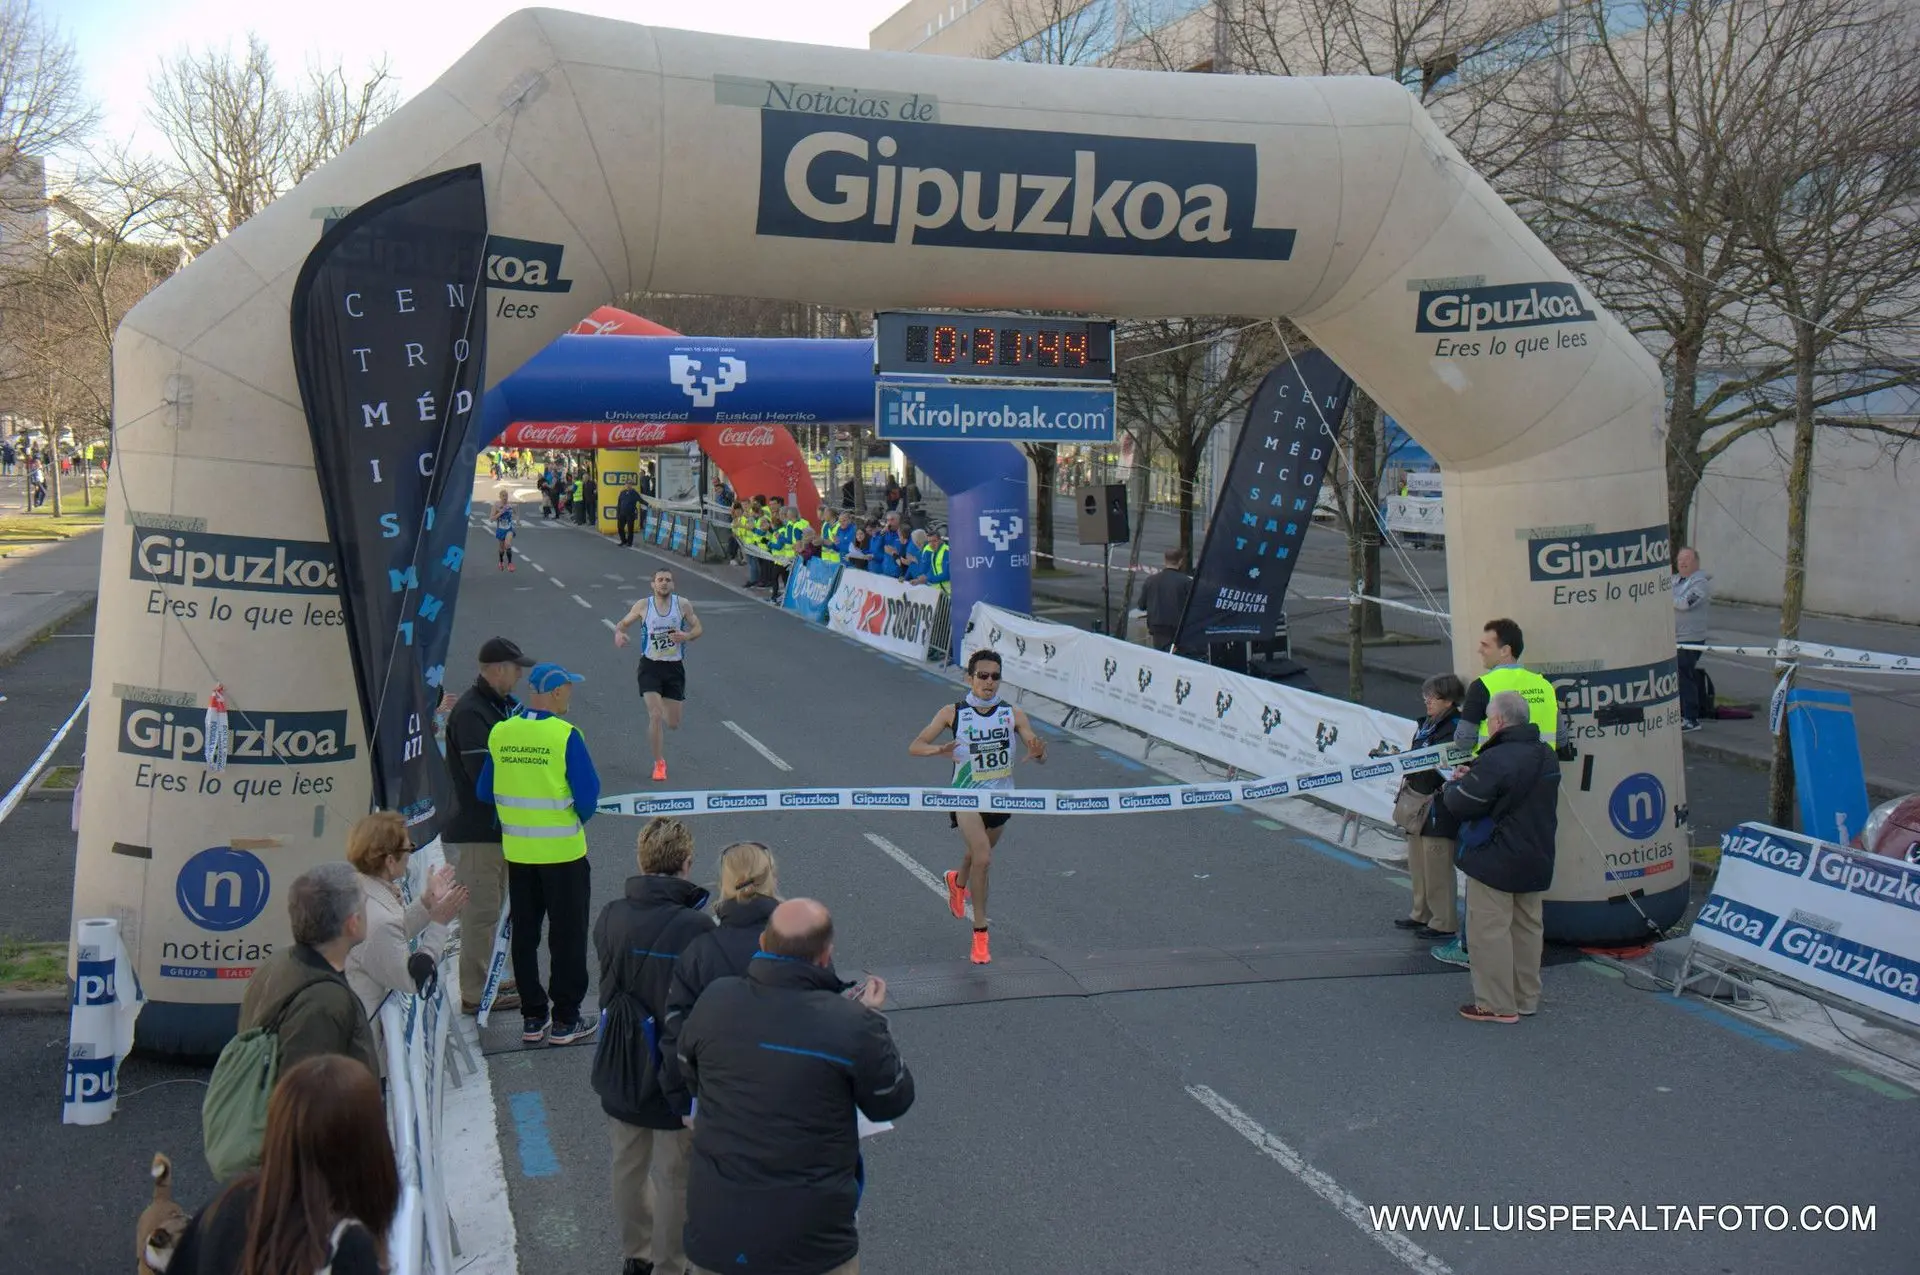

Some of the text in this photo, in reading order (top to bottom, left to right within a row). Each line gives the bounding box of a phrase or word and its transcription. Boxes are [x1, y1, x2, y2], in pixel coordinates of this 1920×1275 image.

[762, 80, 933, 121] Noticias de
[784, 131, 1232, 246] Gipuzkoa
[496, 296, 539, 319] lees
[1426, 288, 1582, 331] Gipuzkoa
[935, 325, 1087, 366] 0:31:44
[1435, 330, 1588, 358] Eres lo que lees
[605, 410, 816, 420] Universidad Euskal Herriko
[900, 402, 1106, 433] Kirolprobak.com
[517, 424, 581, 445] Coca-Cola
[608, 423, 668, 444] Coca-Cola
[718, 426, 776, 447] Coca-Cola
[965, 555, 1030, 569] UPV EHU
[1537, 534, 1670, 578] Gipuzkoa
[1215, 598, 1266, 613] DEPORTIVA
[1219, 587, 1268, 604] MEDICINA
[1553, 585, 1597, 605] Eres
[1606, 582, 1621, 600] lo
[1628, 580, 1655, 602] que
[147, 590, 345, 630] Eres lo que lees
[1637, 715, 1662, 737] que
[974, 750, 1009, 770] 180
[135, 763, 334, 803] Eres lo que lees
[636, 799, 693, 814] Gipuzkoa
[709, 796, 766, 808] Gipuzkoa
[781, 793, 838, 806] Gipuzkoa
[853, 793, 909, 806] Gipuzkoa
[923, 794, 978, 807] Gipuzkoa
[992, 795, 1045, 809] Gipuzkoa
[1057, 798, 1109, 810] Gipuzkoa
[1120, 794, 1170, 808] Gipuzkoa
[1183, 790, 1231, 804] Gipuzkoa
[1242, 781, 1288, 799] Gipuzkoa
[1299, 772, 1342, 790] Gipuzkoa
[1353, 762, 1394, 780] Gipuzkoa
[1605, 842, 1673, 866] noticias
[1721, 833, 1804, 871] uzkoa
[1819, 852, 1920, 906] Gipuzk
[1699, 902, 1765, 940] zkoa
[163, 939, 273, 962] noticias
[1781, 927, 1919, 998] Gipuzkoa
[169, 967, 207, 977] GRUPO
